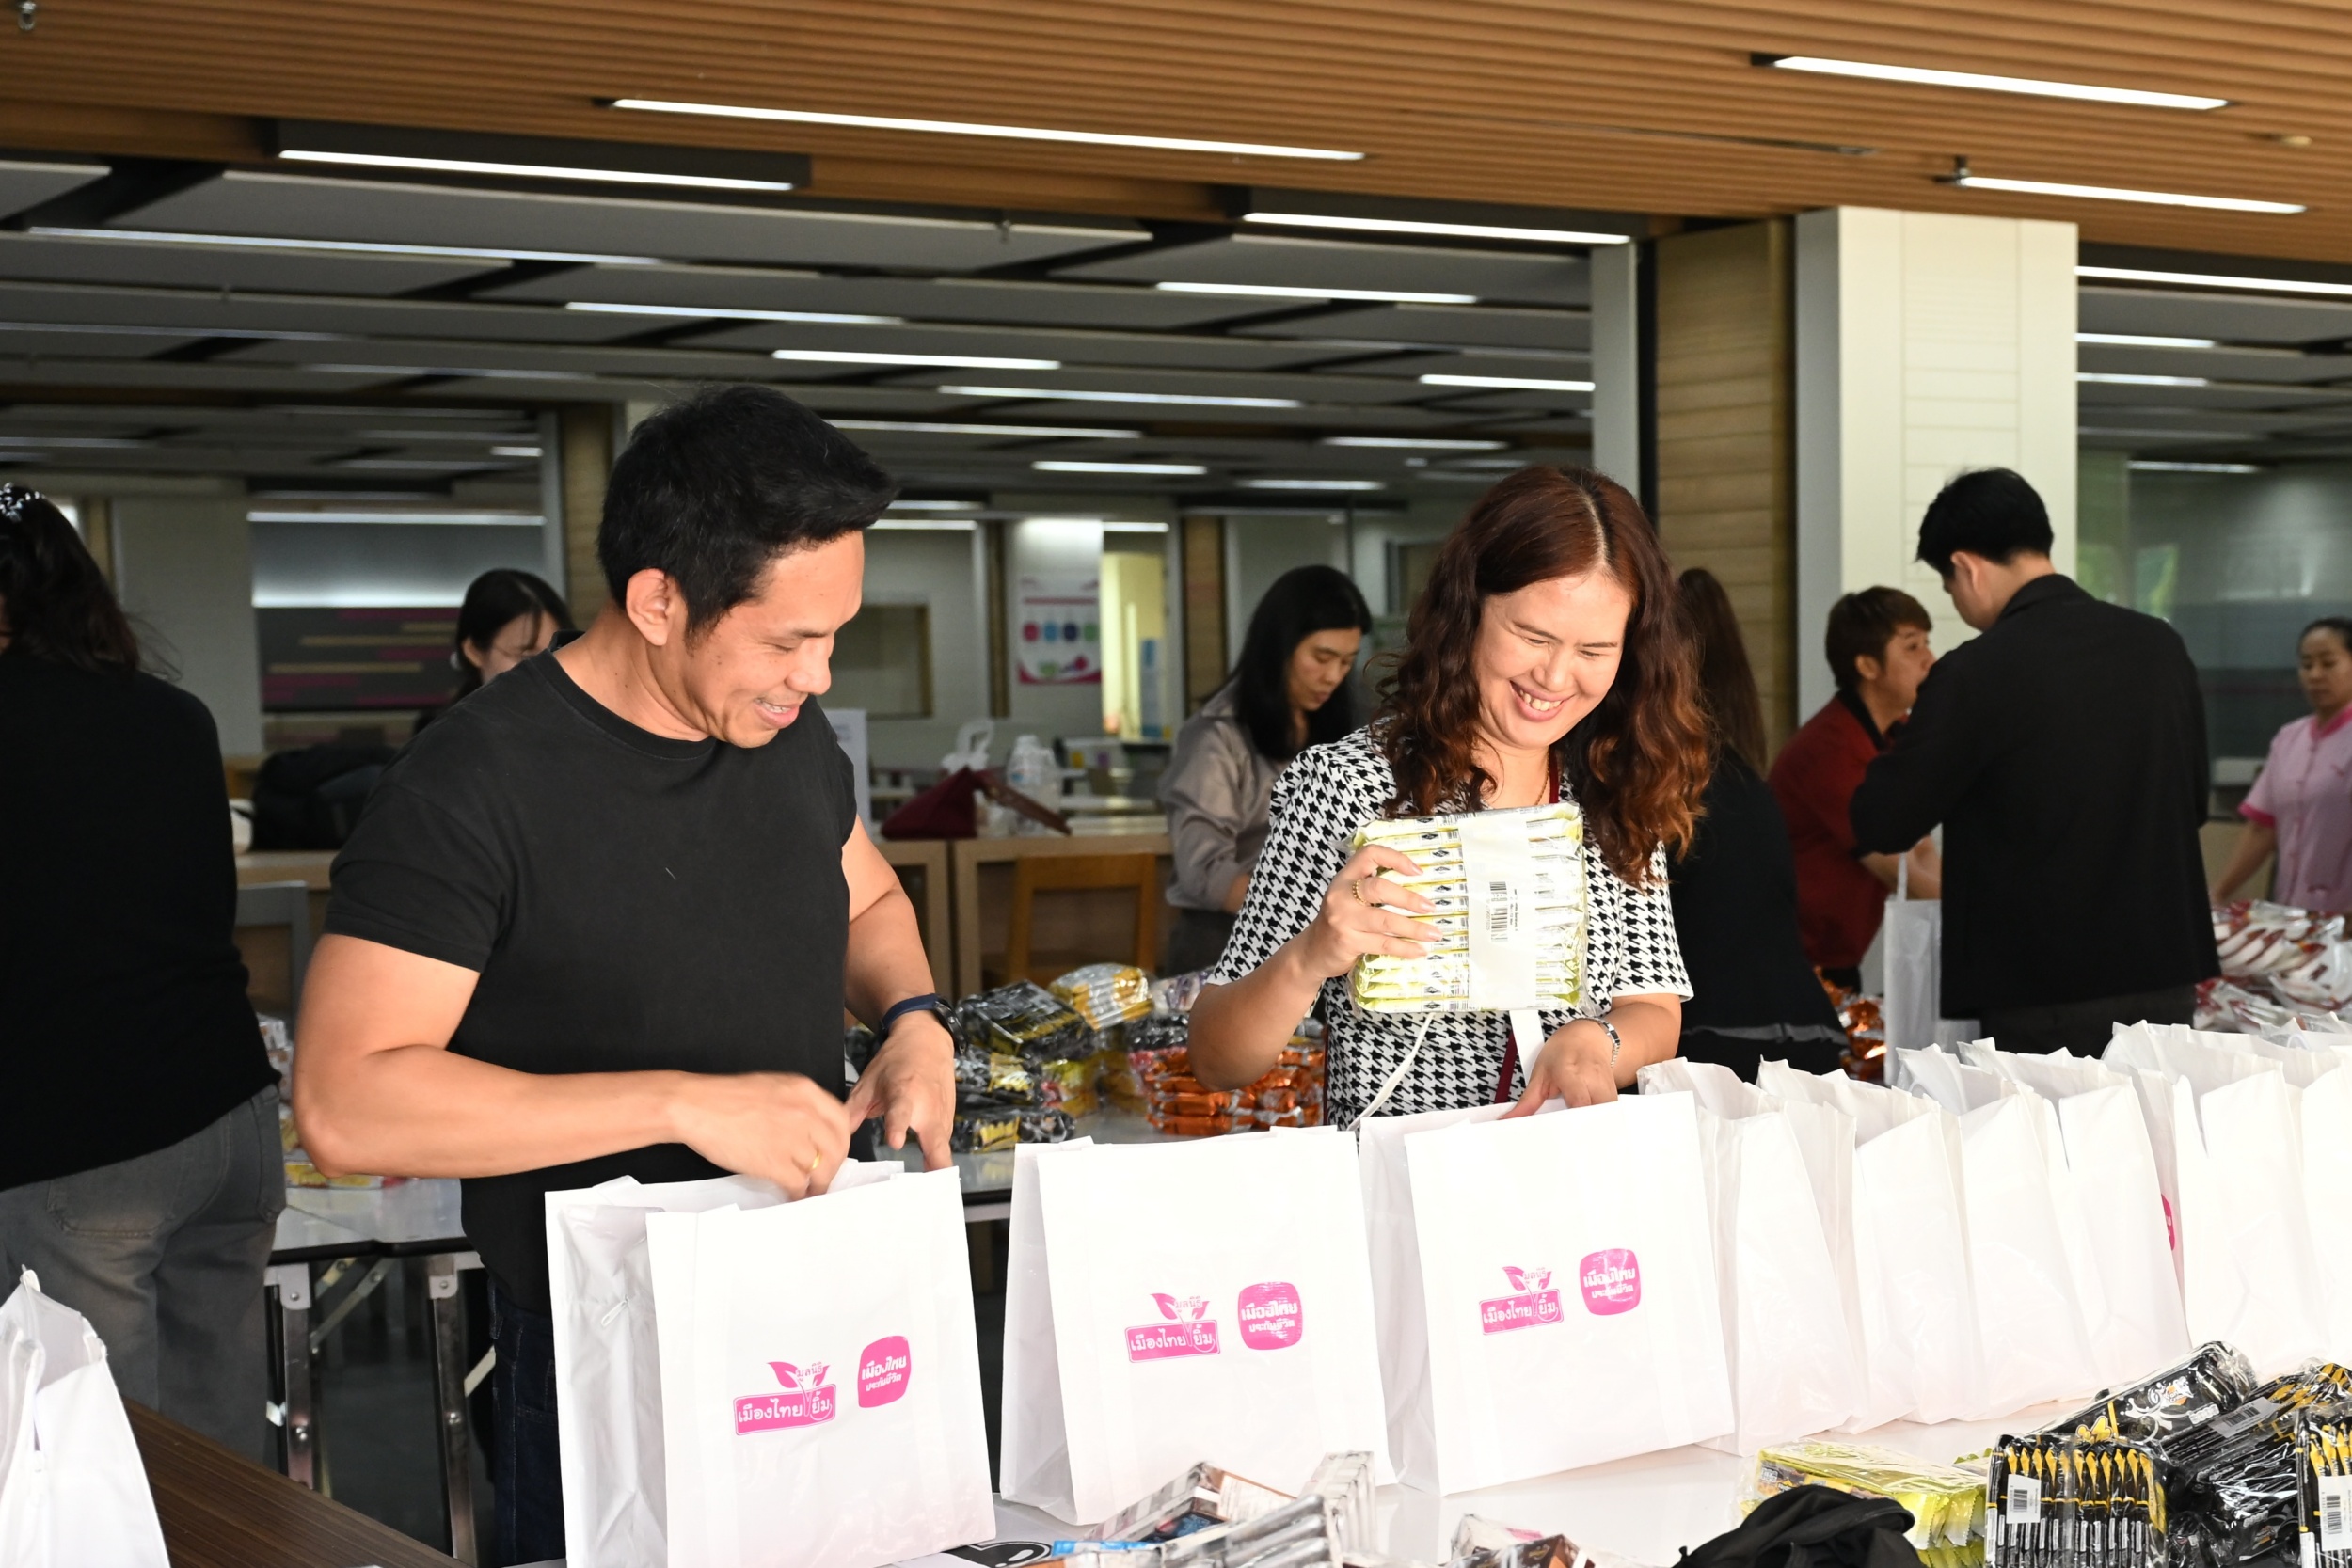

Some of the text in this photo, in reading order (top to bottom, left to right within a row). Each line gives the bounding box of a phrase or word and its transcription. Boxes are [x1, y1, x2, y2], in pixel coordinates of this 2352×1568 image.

[1583, 1267, 1636, 1288] เมืองไทย
[1483, 1294, 1557, 1323] เมืองไทย ยิ้ม
[1130, 1324, 1214, 1351] เมืองไทย ยิ้ม
[795, 1361, 823, 1381] มูลนิธิ
[862, 1355, 907, 1380] เมืองไทย
[738, 1390, 832, 1423] เมืองไทย ยิ้ม
